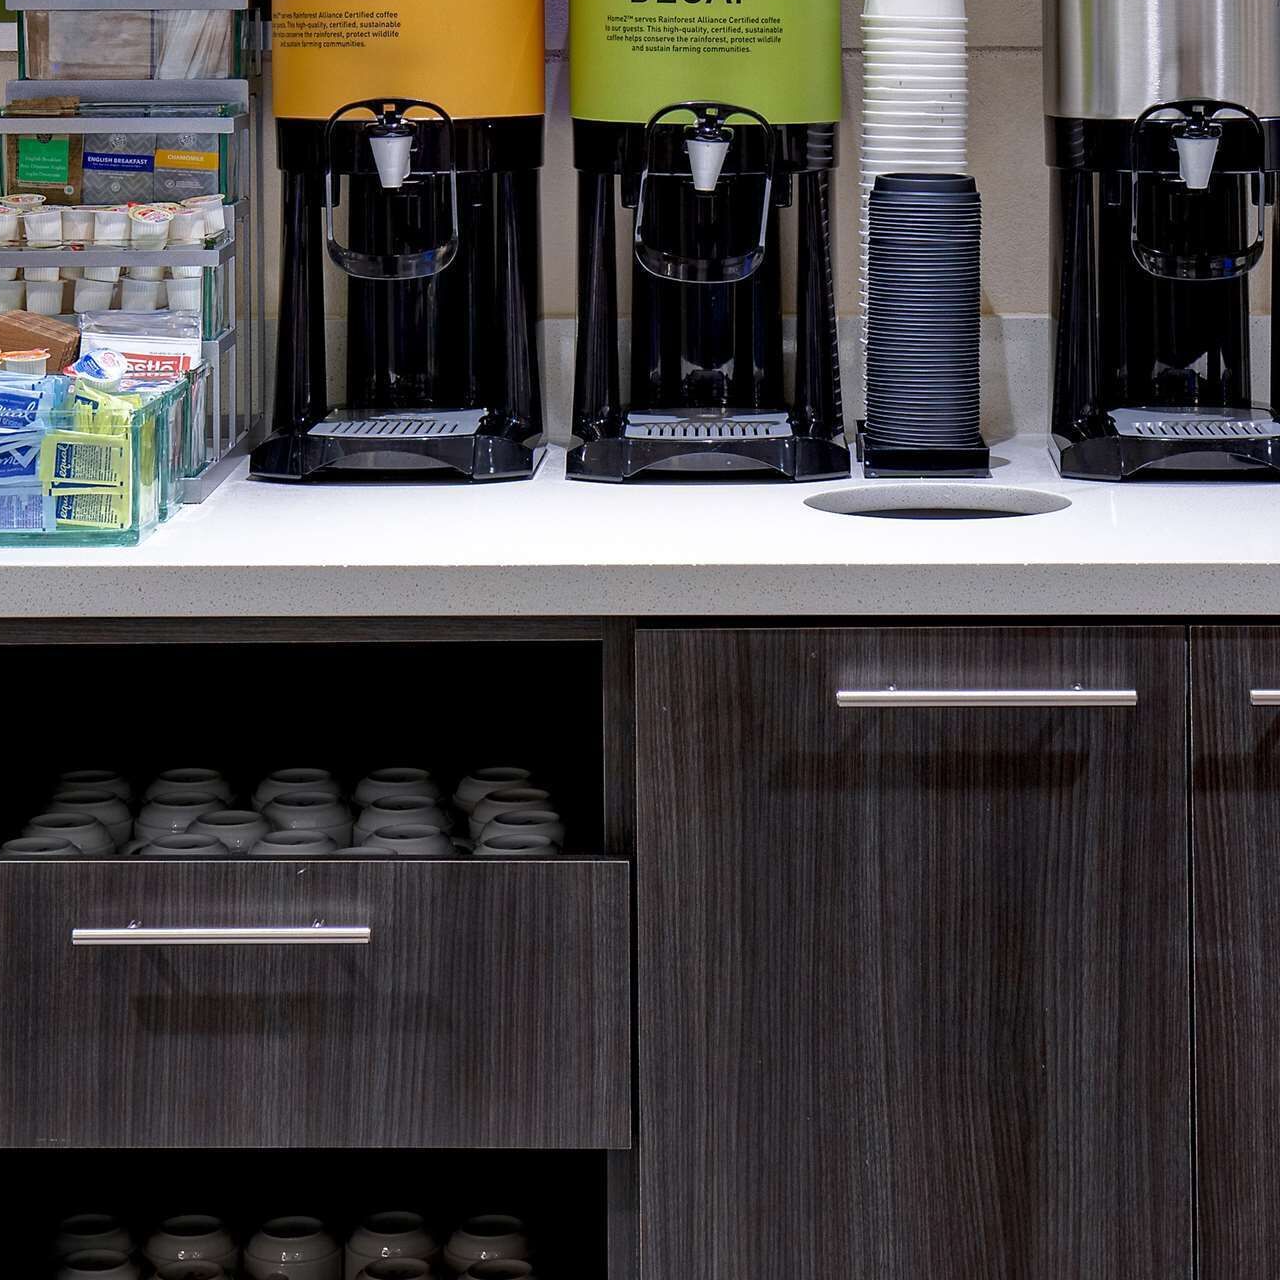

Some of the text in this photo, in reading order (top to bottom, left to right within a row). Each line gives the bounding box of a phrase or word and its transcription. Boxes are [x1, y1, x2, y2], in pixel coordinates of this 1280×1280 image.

[318, 11, 343, 19] Alliance
[344, 11, 374, 19] Certified
[376, 11, 398, 19] coffee
[360, 21, 401, 29] sustainable
[745, 26, 783, 34] sustainable
[346, 31, 370, 39] protect
[372, 31, 399, 39] wildlife
[625, 35, 642, 43] helps
[676, 35, 688, 43] the
[730, 36, 756, 44] protect
[672, 45, 701, 54] farming
[126, 358, 175, 377] estlé
[58, 444, 70, 477] equal
